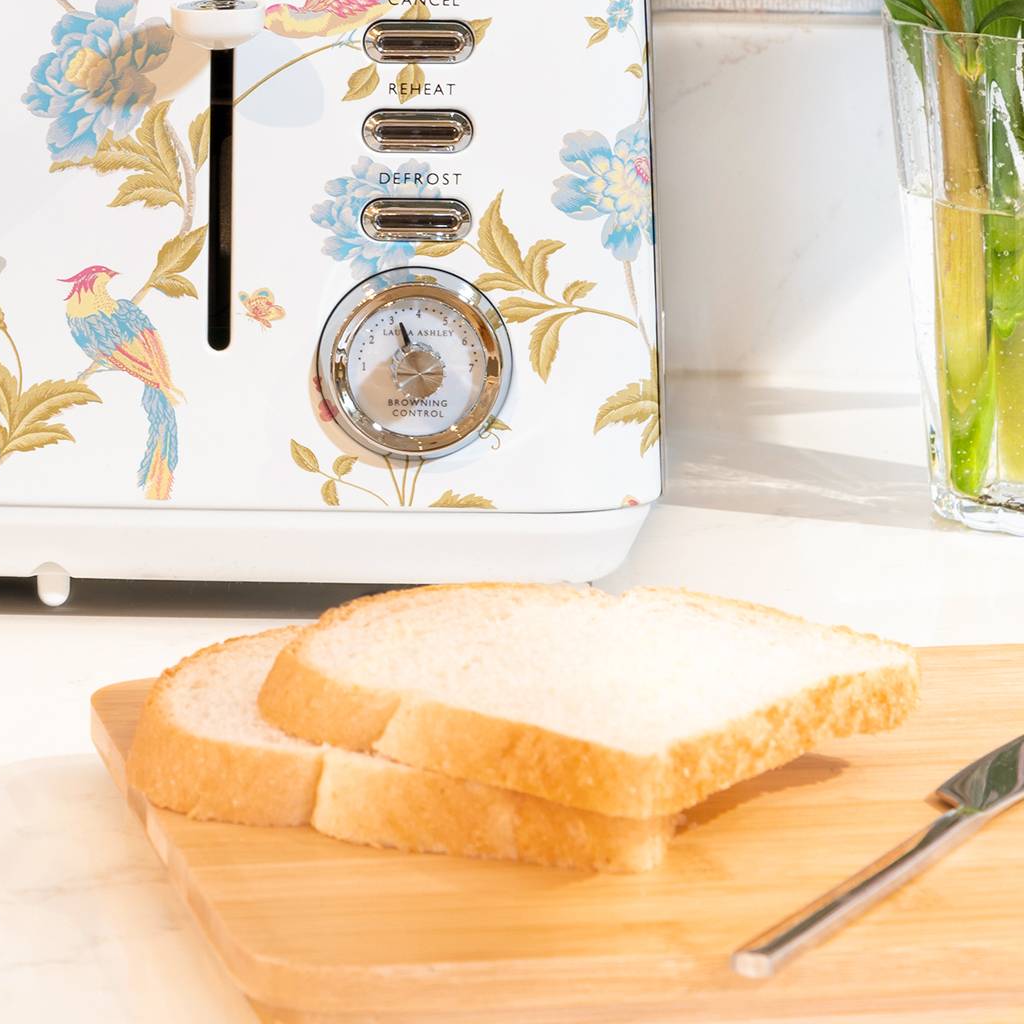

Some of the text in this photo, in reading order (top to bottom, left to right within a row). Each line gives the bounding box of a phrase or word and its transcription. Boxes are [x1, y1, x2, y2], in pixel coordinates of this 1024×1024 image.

[388, 82, 456, 96] REHEAT
[379, 172, 462, 186] DEFROST
[383, 329, 455, 337] LAUA ASHLEY
[369, 335, 375, 344] 2
[389, 316, 394, 325] 3
[415, 309, 421, 319] 4
[442, 317, 449, 326] 5
[462, 338, 468, 346] 6
[468, 363, 474, 373] 7
[387, 399, 448, 408] BROWNING
[392, 409, 444, 418] CONTROL
